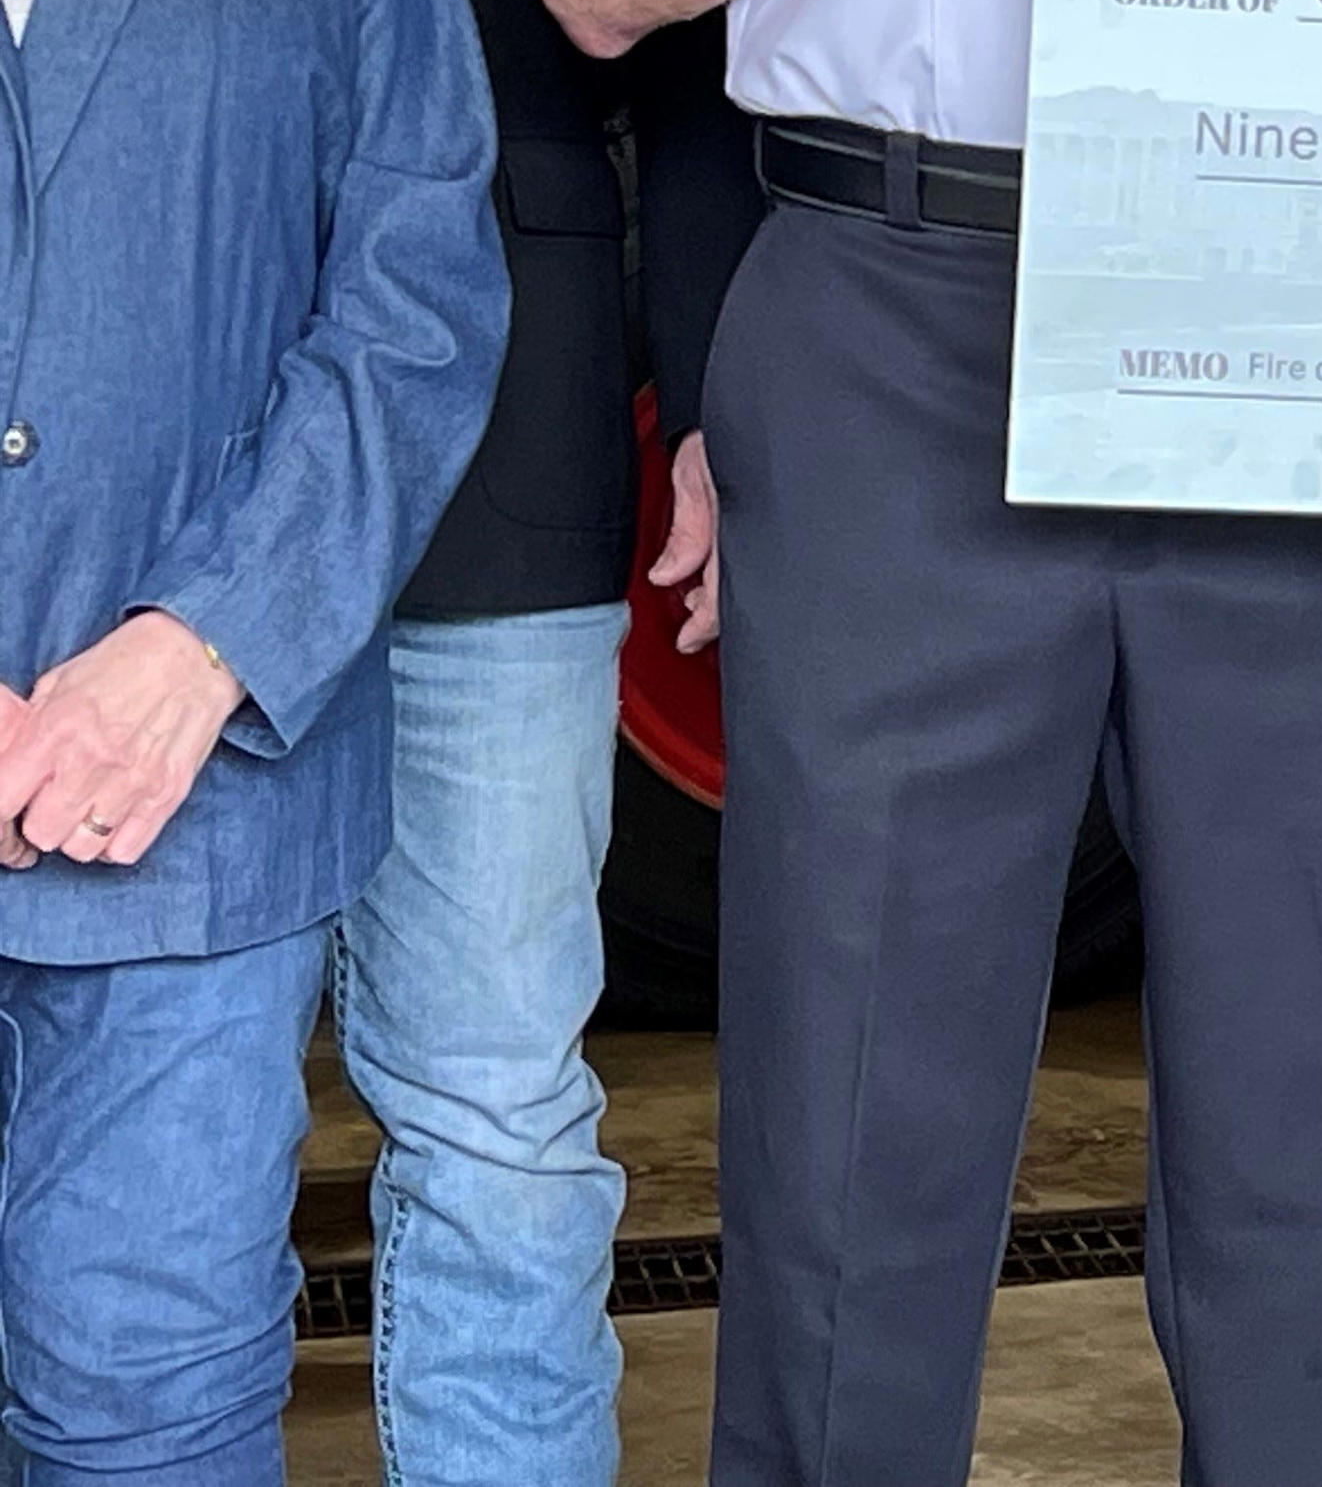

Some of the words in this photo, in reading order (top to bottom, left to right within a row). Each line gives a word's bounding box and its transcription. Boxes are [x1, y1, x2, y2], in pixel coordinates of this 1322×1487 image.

[1195, 111, 1320, 162] Nine
[1119, 348, 1229, 382] MEMO
[1248, 351, 1307, 382] Fire
